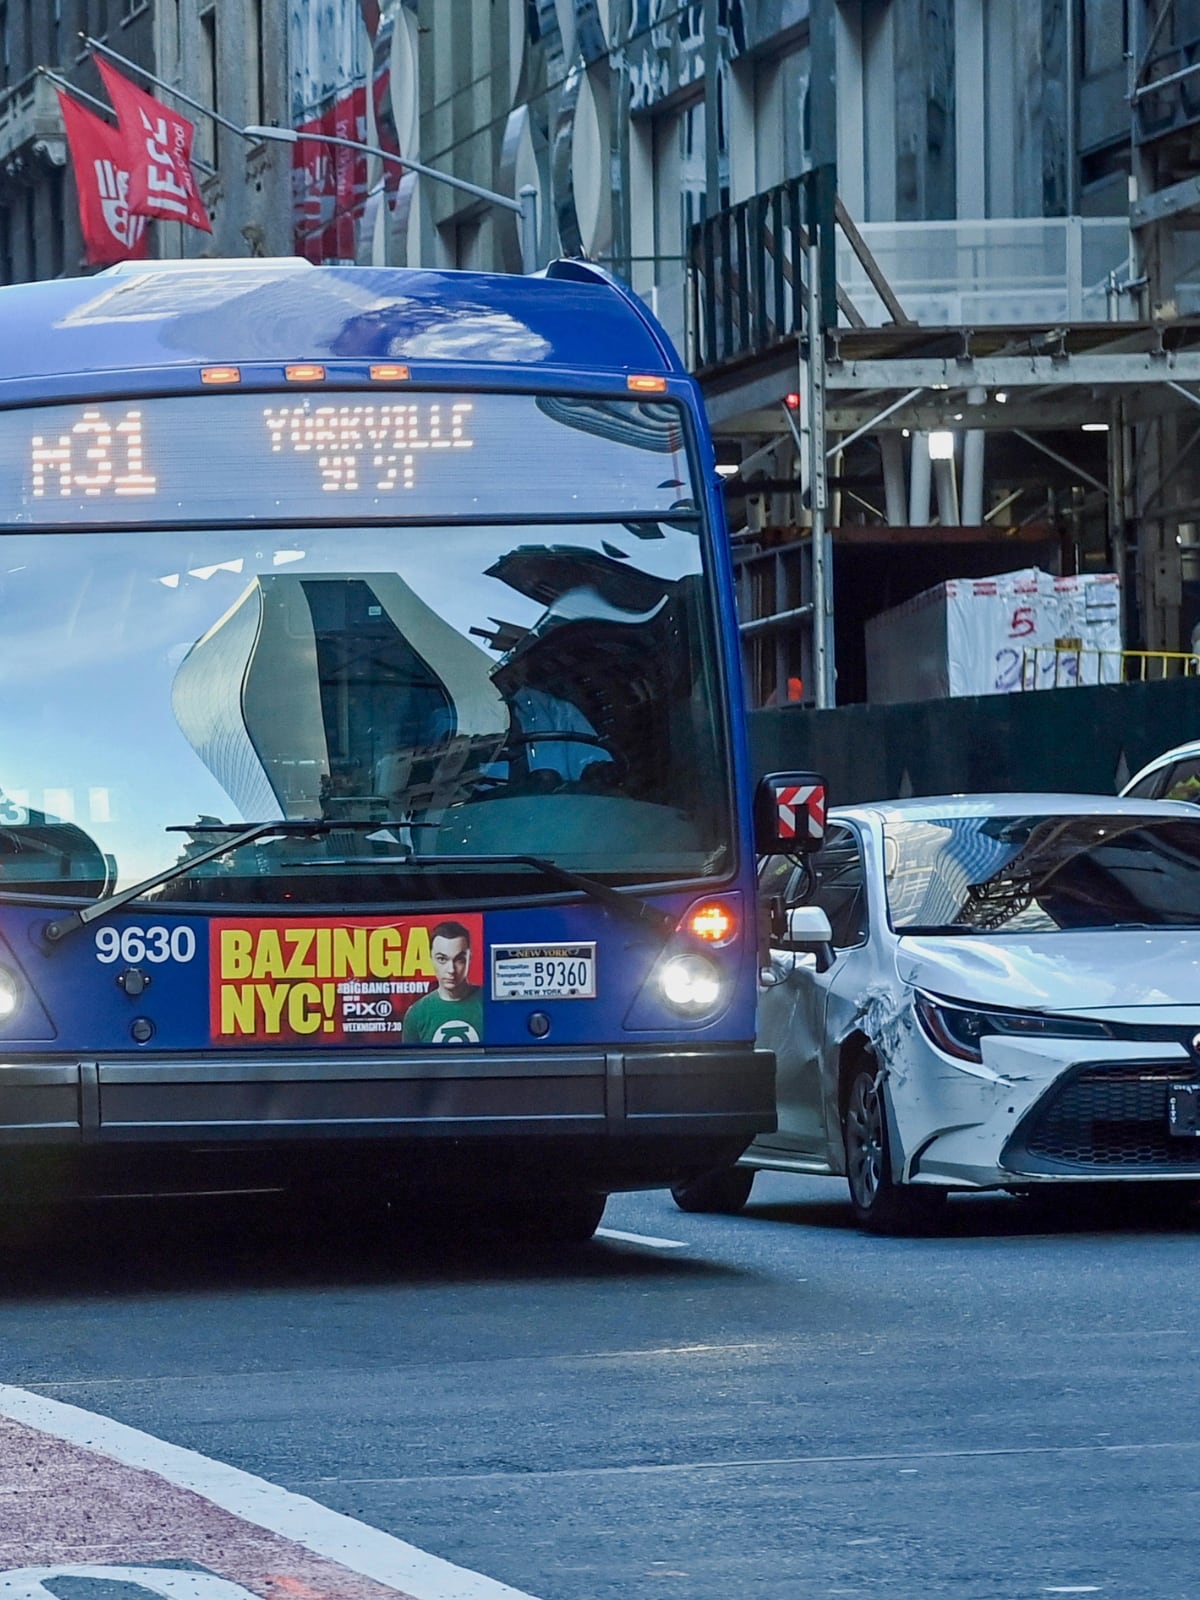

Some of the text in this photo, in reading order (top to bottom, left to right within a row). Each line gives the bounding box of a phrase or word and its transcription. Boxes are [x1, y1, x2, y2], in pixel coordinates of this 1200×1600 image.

[263, 403, 473, 451] YORKVILLE
[31, 407, 157, 496] M31
[1008, 607, 1036, 638] 5
[95, 925, 196, 964] 9630
[220, 926, 437, 980] BAZINGA
[519, 948, 568, 958] NEW YORK
[220, 981, 336, 1035] NYC!
